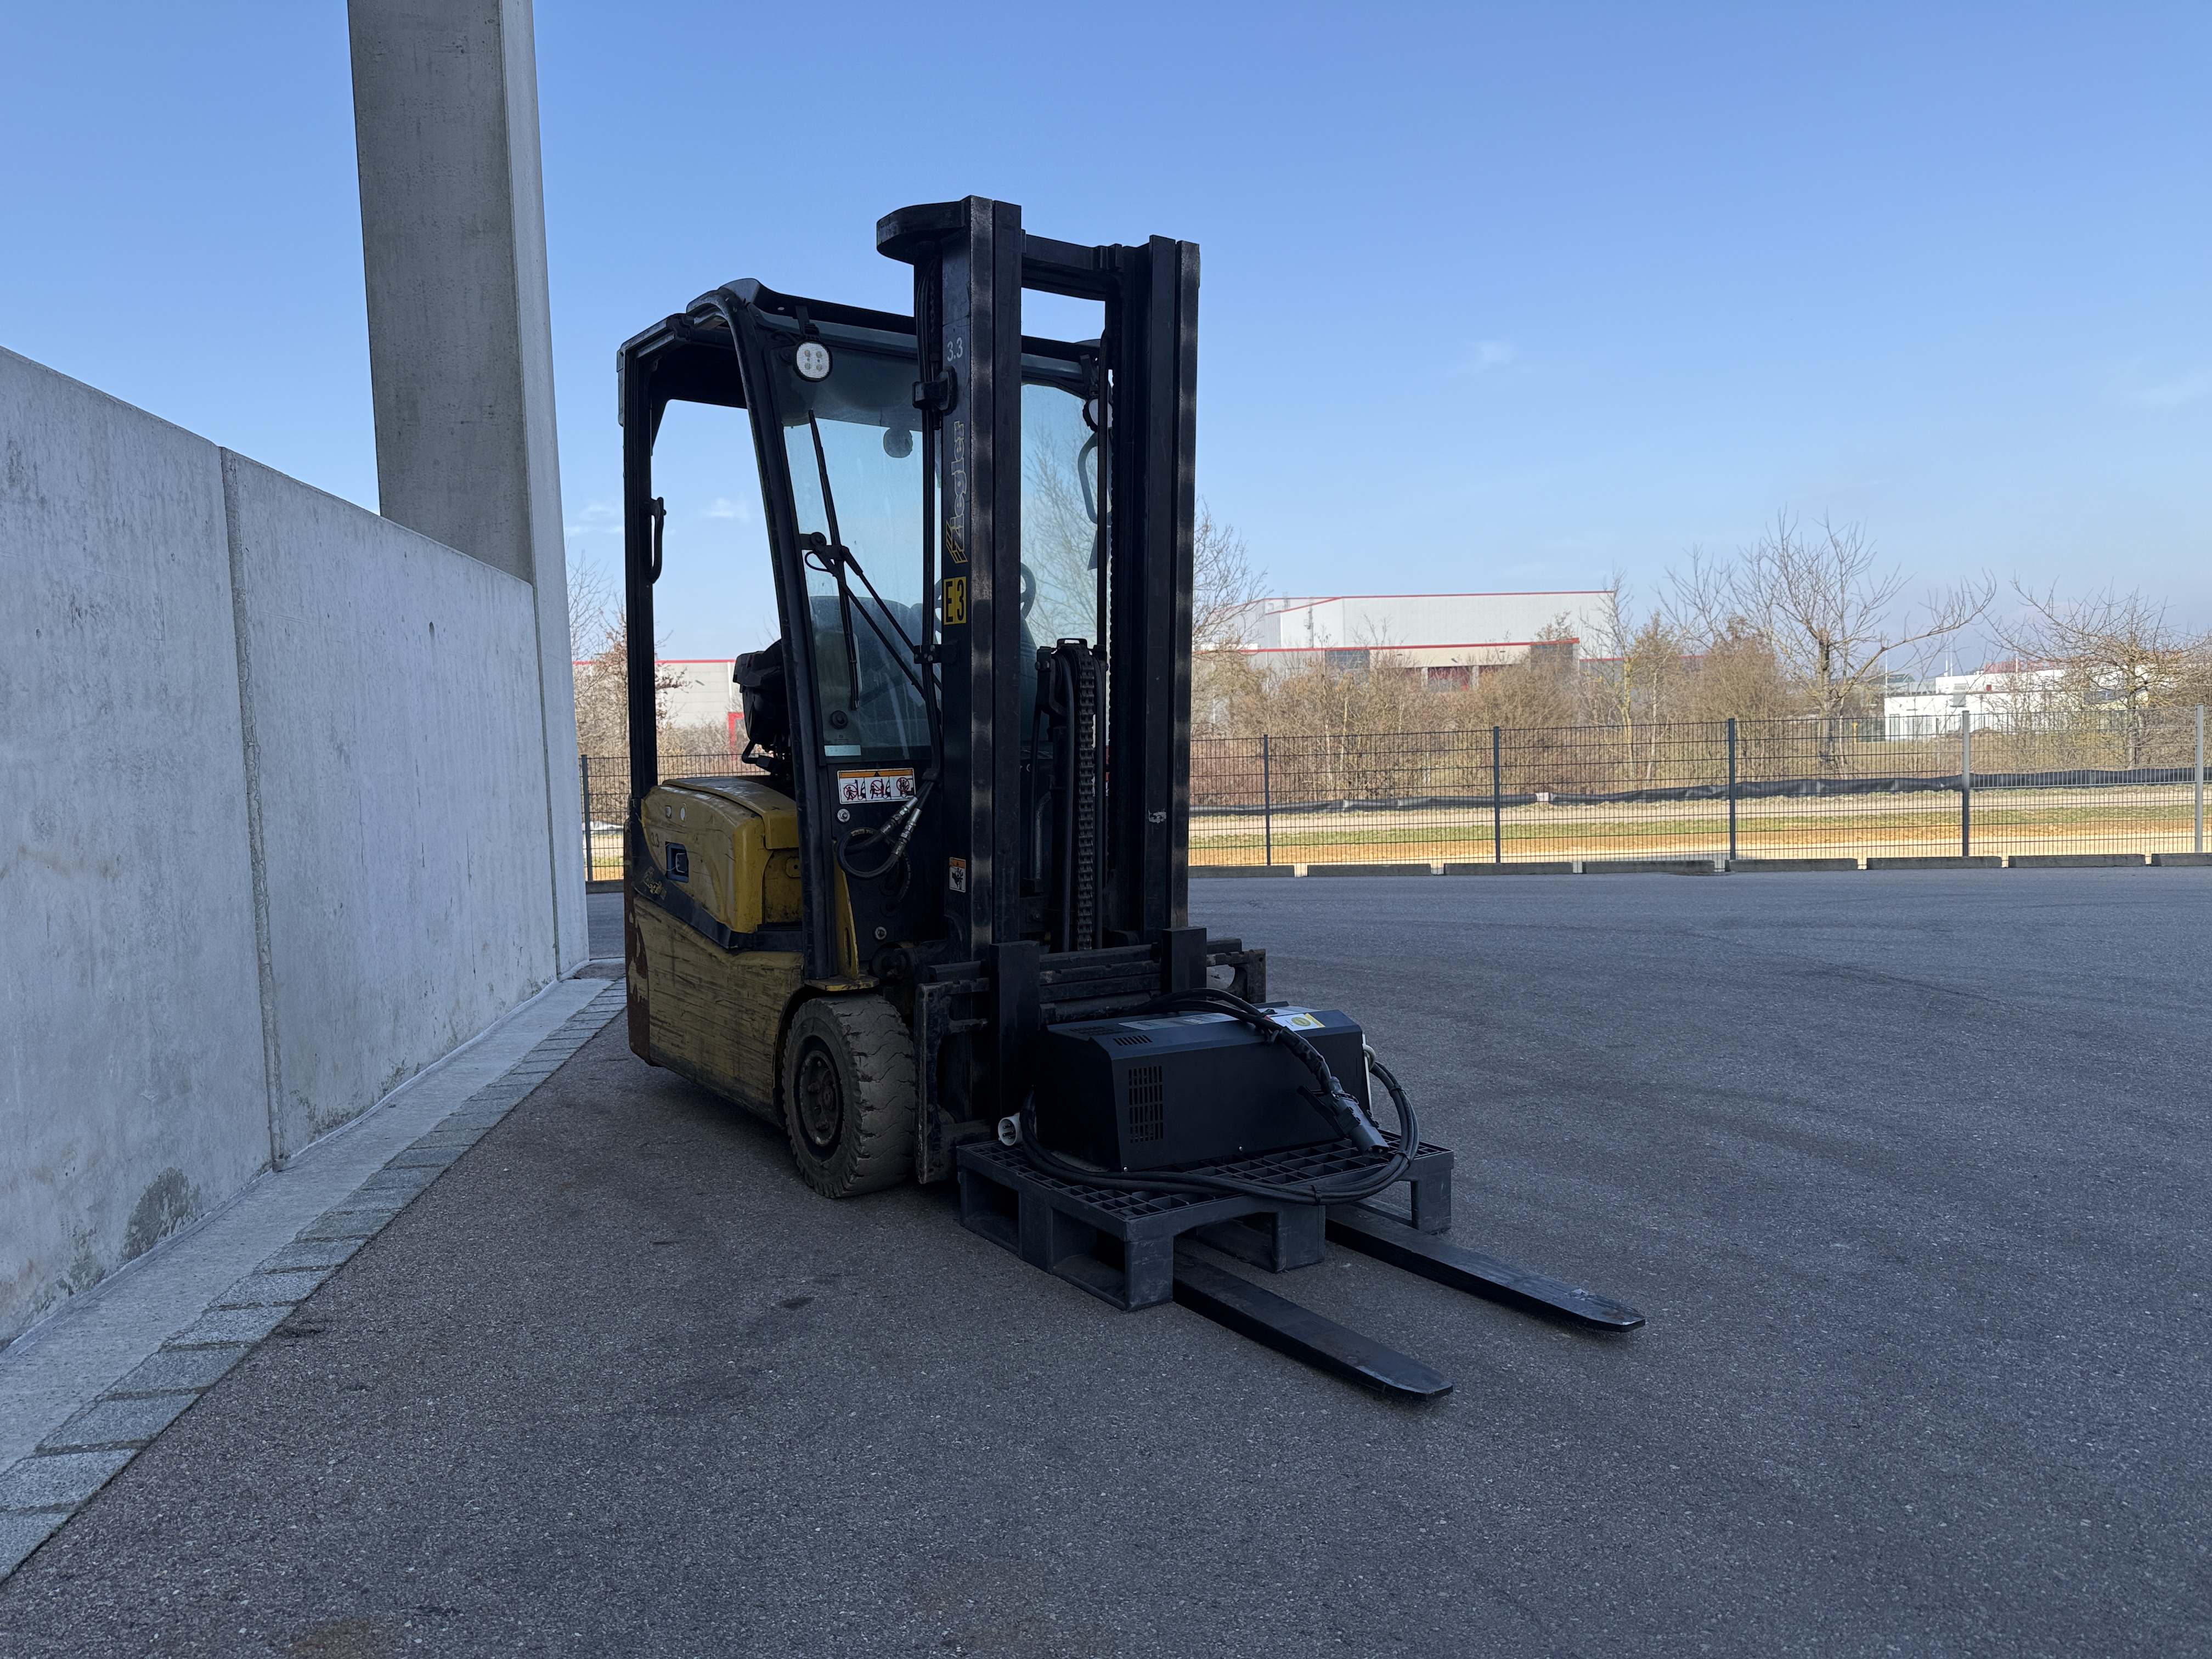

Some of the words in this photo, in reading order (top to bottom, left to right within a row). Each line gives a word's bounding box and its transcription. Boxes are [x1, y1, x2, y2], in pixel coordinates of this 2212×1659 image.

[947, 337, 963, 362] 3.3
[948, 421, 967, 557] Ziegler
[945, 579, 964, 623] E3
